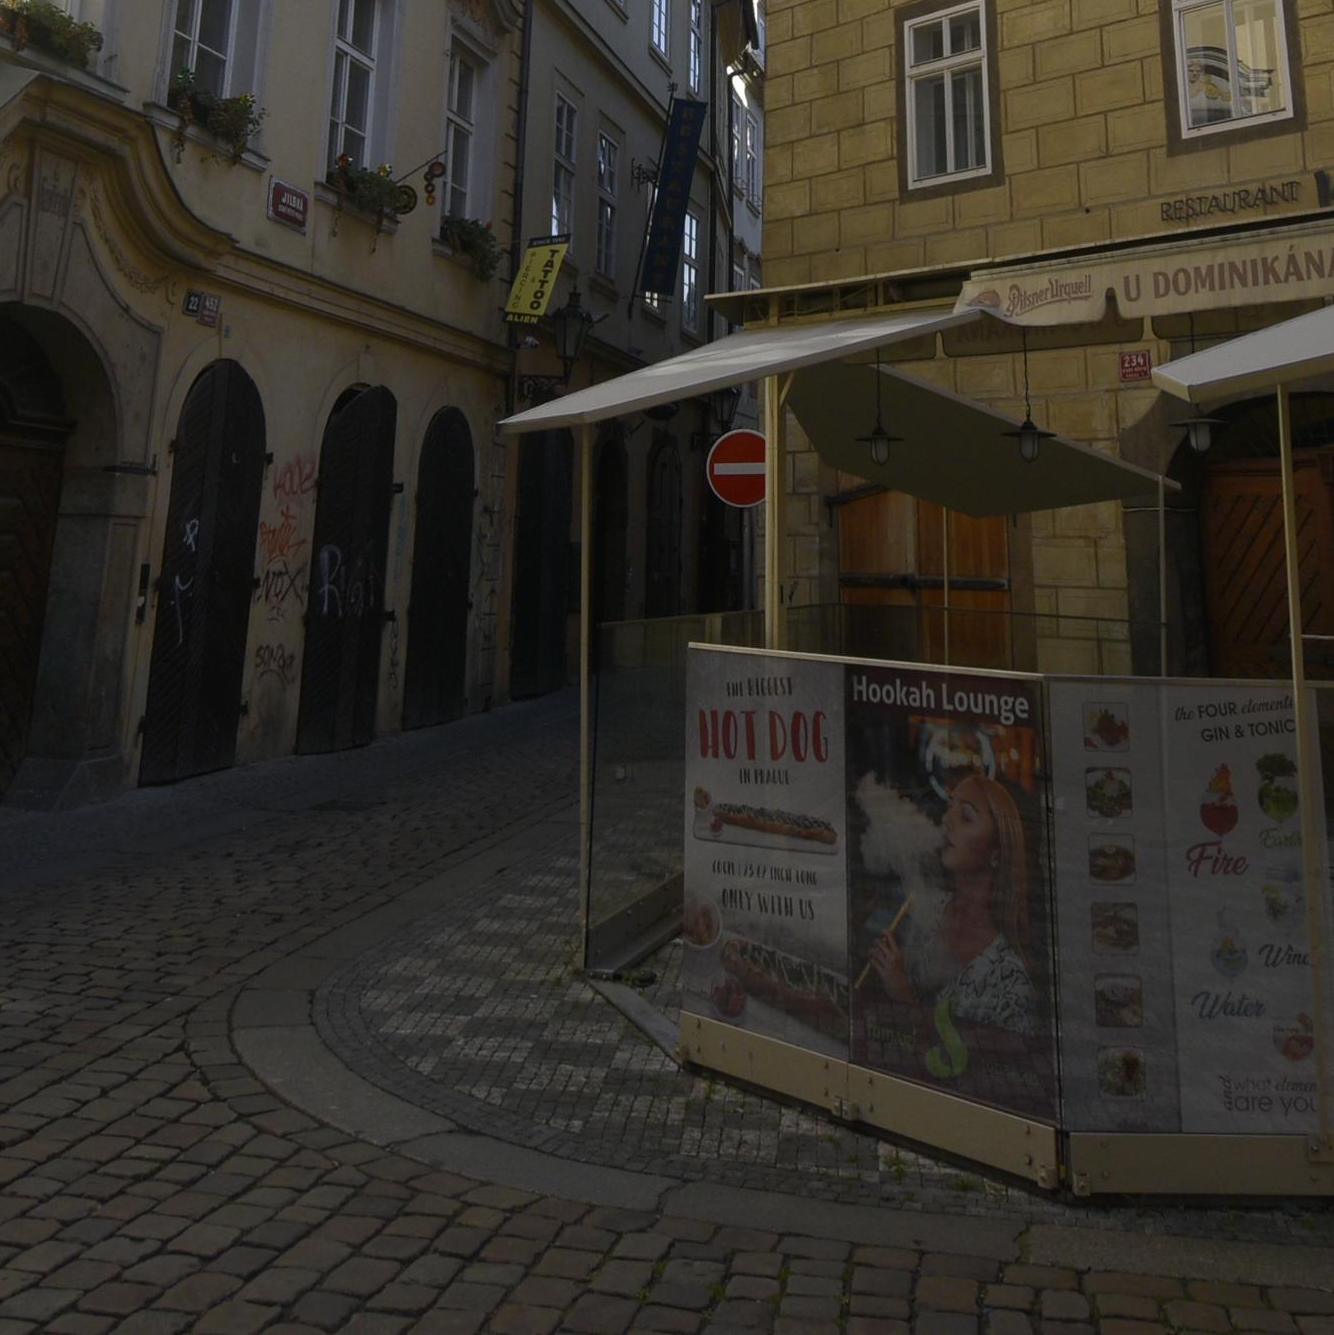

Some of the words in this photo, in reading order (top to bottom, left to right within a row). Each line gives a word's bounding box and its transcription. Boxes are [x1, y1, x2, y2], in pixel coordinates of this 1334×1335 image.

[1160, 180, 1302, 223] RESTAURANT
[530, 249, 559, 310] TATTOO
[1123, 274, 1142, 302] U
[188, 296, 198, 311] 22
[1005, 284, 1050, 317] Pilsner
[1048, 274, 1092, 304] Urquell
[506, 313, 539, 324] ALIEN
[1123, 354, 1144, 368] 234
[726, 682, 743, 697] THE
[747, 676, 793, 697] BIGGEST
[852, 675, 935, 709] Hookah
[941, 682, 1029, 725] Lounge
[1174, 705, 1196, 722] the
[1197, 702, 1238, 719] FOUR
[1241, 693, 1293, 714] elements
[698, 709, 757, 761] HOT
[768, 710, 829, 763] DOG
[1200, 726, 1230, 742] GIN
[1234, 724, 1245, 739] &
[1247, 718, 1296, 737] TONIC
[739, 768, 752, 784] IN
[753, 768, 790, 785] PRAGUE
[1186, 840, 1249, 878] Fire
[722, 888, 753, 911] ONLY
[758, 893, 793, 917] WITH
[799, 898, 814, 921] US
[1191, 990, 1267, 1020] Water
[1274, 1076, 1317, 1093] elemen
[1234, 1096, 1273, 1113] are
